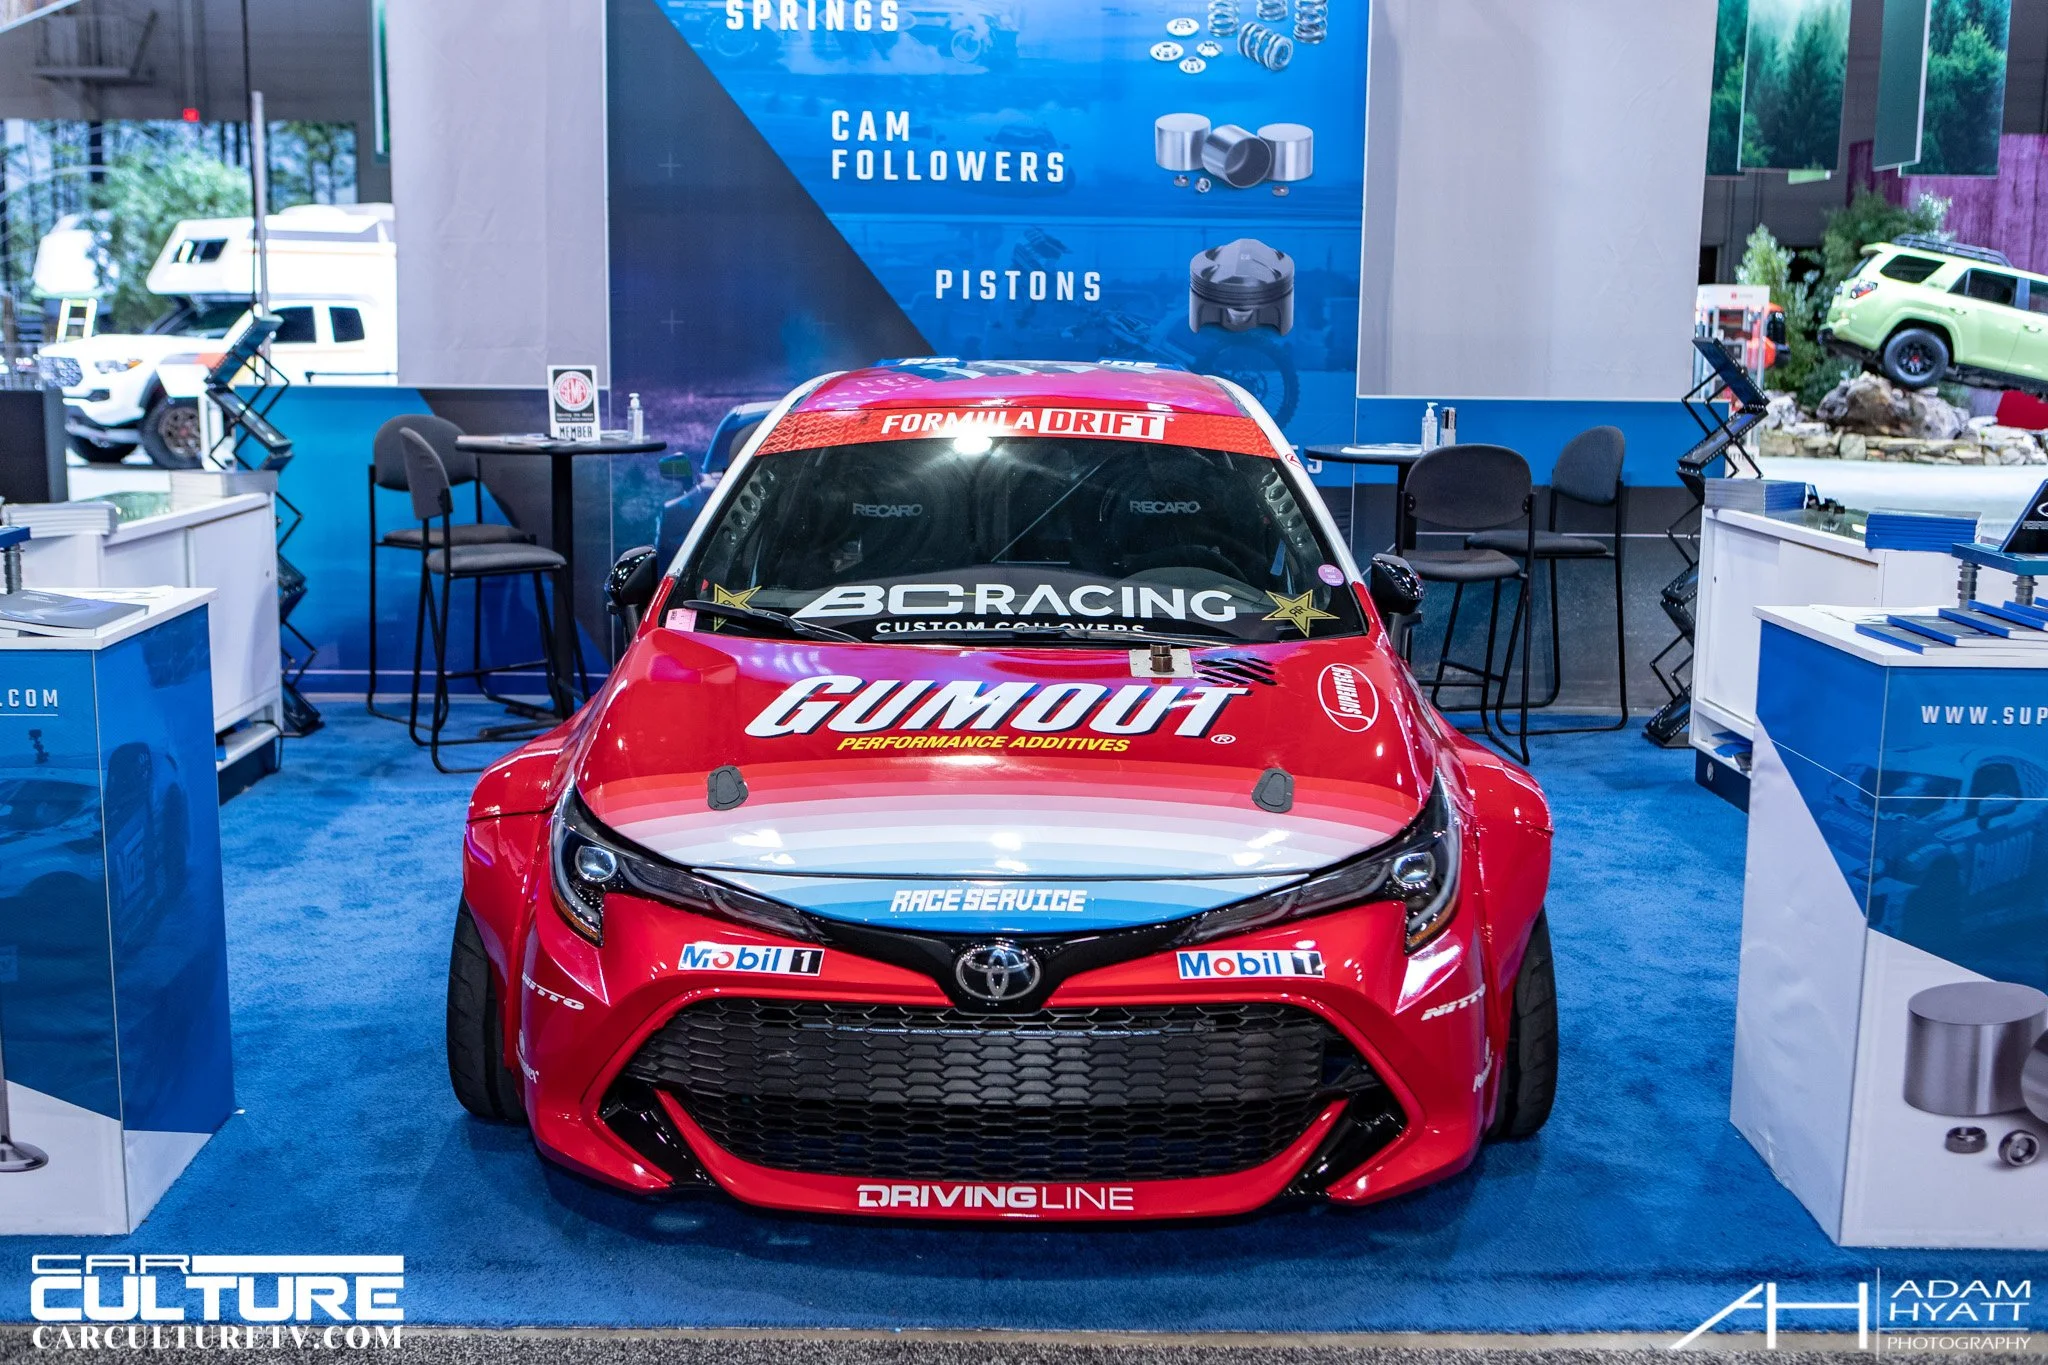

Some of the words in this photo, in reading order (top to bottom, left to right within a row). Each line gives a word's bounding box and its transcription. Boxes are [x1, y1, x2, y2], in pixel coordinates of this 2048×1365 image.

[726, 0, 898, 32] SPRINGS
[831, 110, 910, 142] CAM
[831, 149, 1065, 183] FOLLOWERS
[935, 269, 1101, 302] PISTONS
[559, 425, 593, 439] MEMBER
[881, 410, 1035, 435] FORMULA
[1047, 410, 1158, 437] DRIFT
[852, 502, 923, 518] RECARO
[1129, 500, 1201, 515] RECARO
[974, 583, 1237, 623] RACING
[875, 621, 986, 634] CUSTOM
[1331, 667, 1363, 716] SUPERTECH
[744, 675, 1249, 738] GUMOUT
[836, 734, 1010, 751] PERFORMANCE
[1011, 736, 1132, 752] ADDITIVES
[890, 888, 963, 912] RACE
[961, 888, 1088, 912] SERVICE
[681, 944, 783, 972] Mobil
[799, 950, 811, 973] 1
[1180, 951, 1283, 977] Mobil
